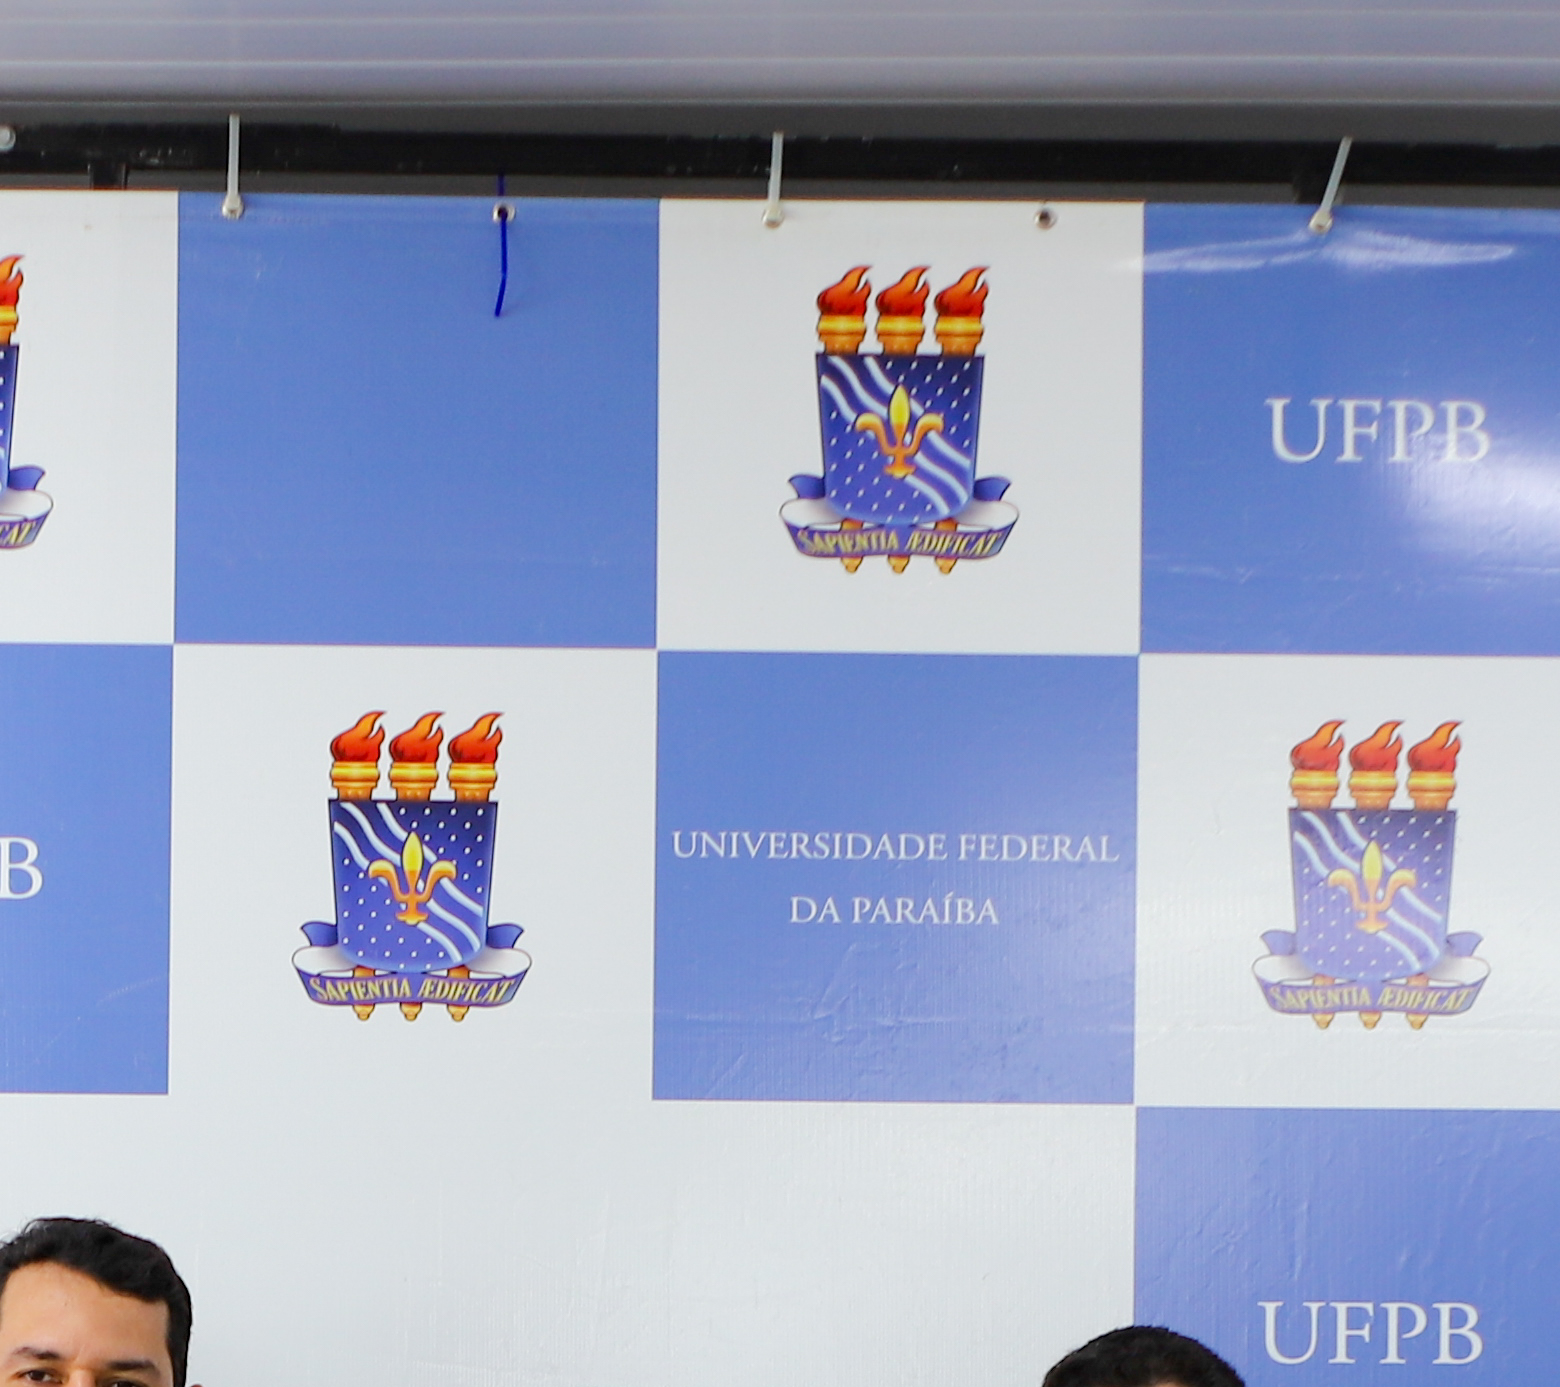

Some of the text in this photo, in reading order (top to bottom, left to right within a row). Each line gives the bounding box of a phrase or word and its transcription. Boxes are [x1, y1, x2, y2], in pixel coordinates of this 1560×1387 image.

[1264, 397, 1490, 464] UFPB
[797, 529, 899, 553] SAPIENTIA
[672, 830, 1119, 861] UNIVERSIDADE FEDERAL
[790, 891, 999, 925] DA PARAÍBA
[308, 978, 411, 1001] SAPIENTIA
[1259, 1300, 1484, 1366] UFPB
